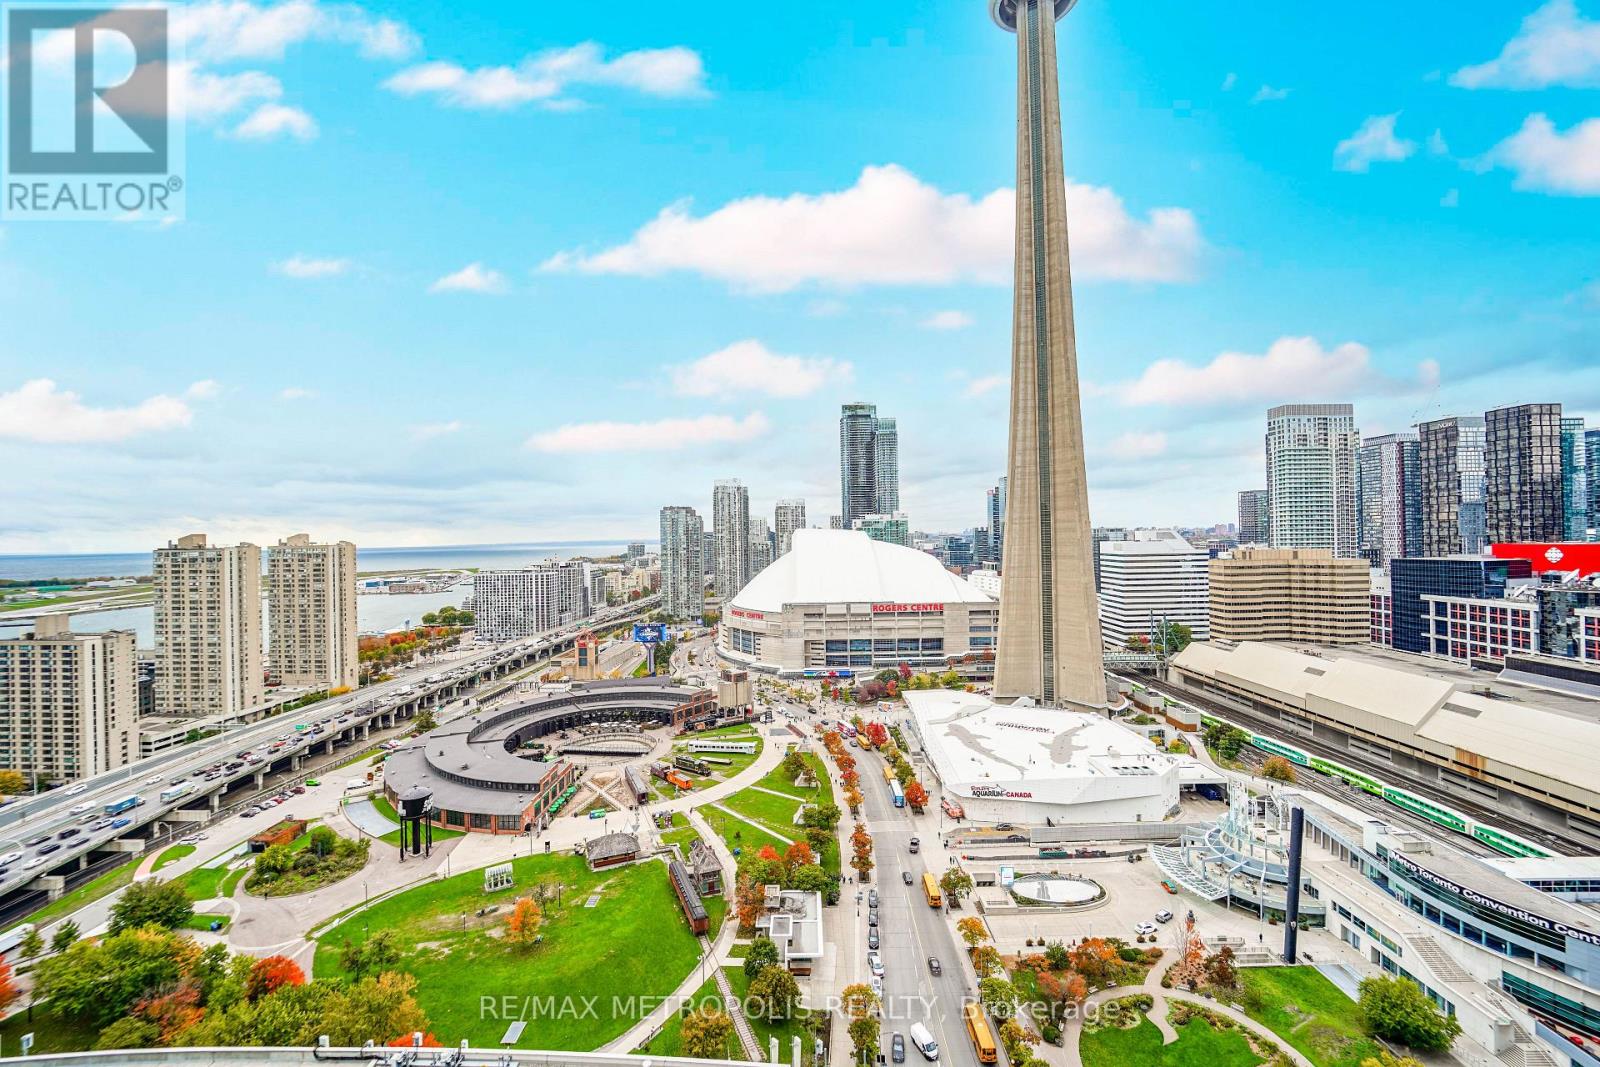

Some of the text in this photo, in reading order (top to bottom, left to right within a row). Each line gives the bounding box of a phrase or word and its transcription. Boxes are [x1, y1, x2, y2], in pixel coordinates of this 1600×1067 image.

[873, 603, 944, 612] ROGERS CENTRE
[972, 790, 1003, 798] AQUARIUM
[1006, 791, 1033, 799] CANADA
[1390, 851, 1417, 872] Metro
[1418, 867, 1460, 893] Toronto
[1463, 889, 1550, 929] Convention
